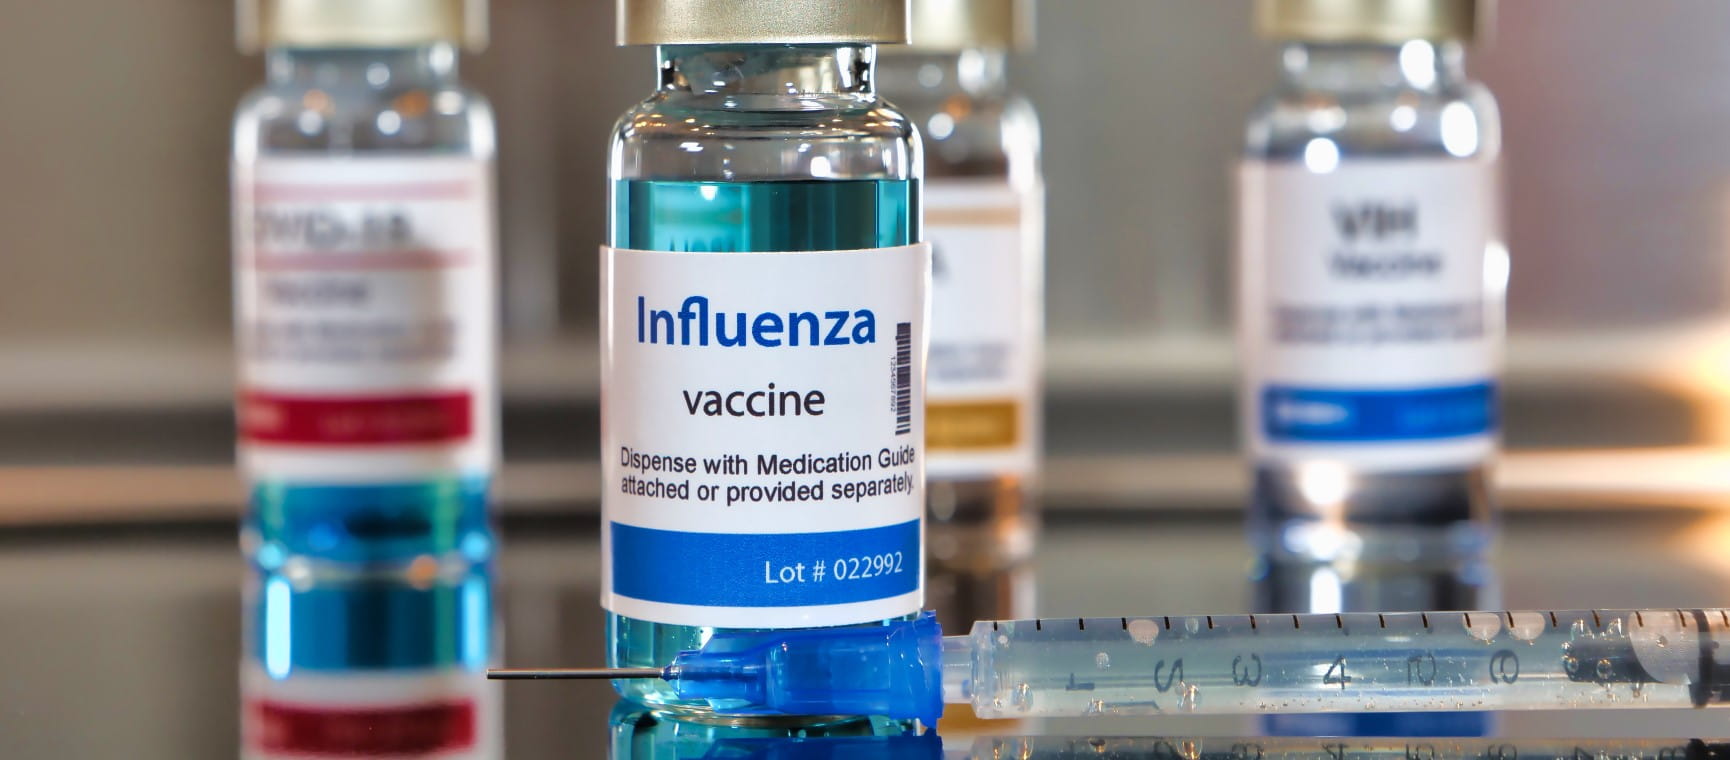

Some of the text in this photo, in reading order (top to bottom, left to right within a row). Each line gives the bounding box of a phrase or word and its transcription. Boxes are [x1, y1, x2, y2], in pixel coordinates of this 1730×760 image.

[637, 295, 876, 348] Influenza
[683, 382, 826, 417] vaccine
[621, 444, 915, 476] Dispense with Medication Guide
[621, 471, 914, 507] attached or provided separately.
[765, 551, 903, 584] Lot # 022992
